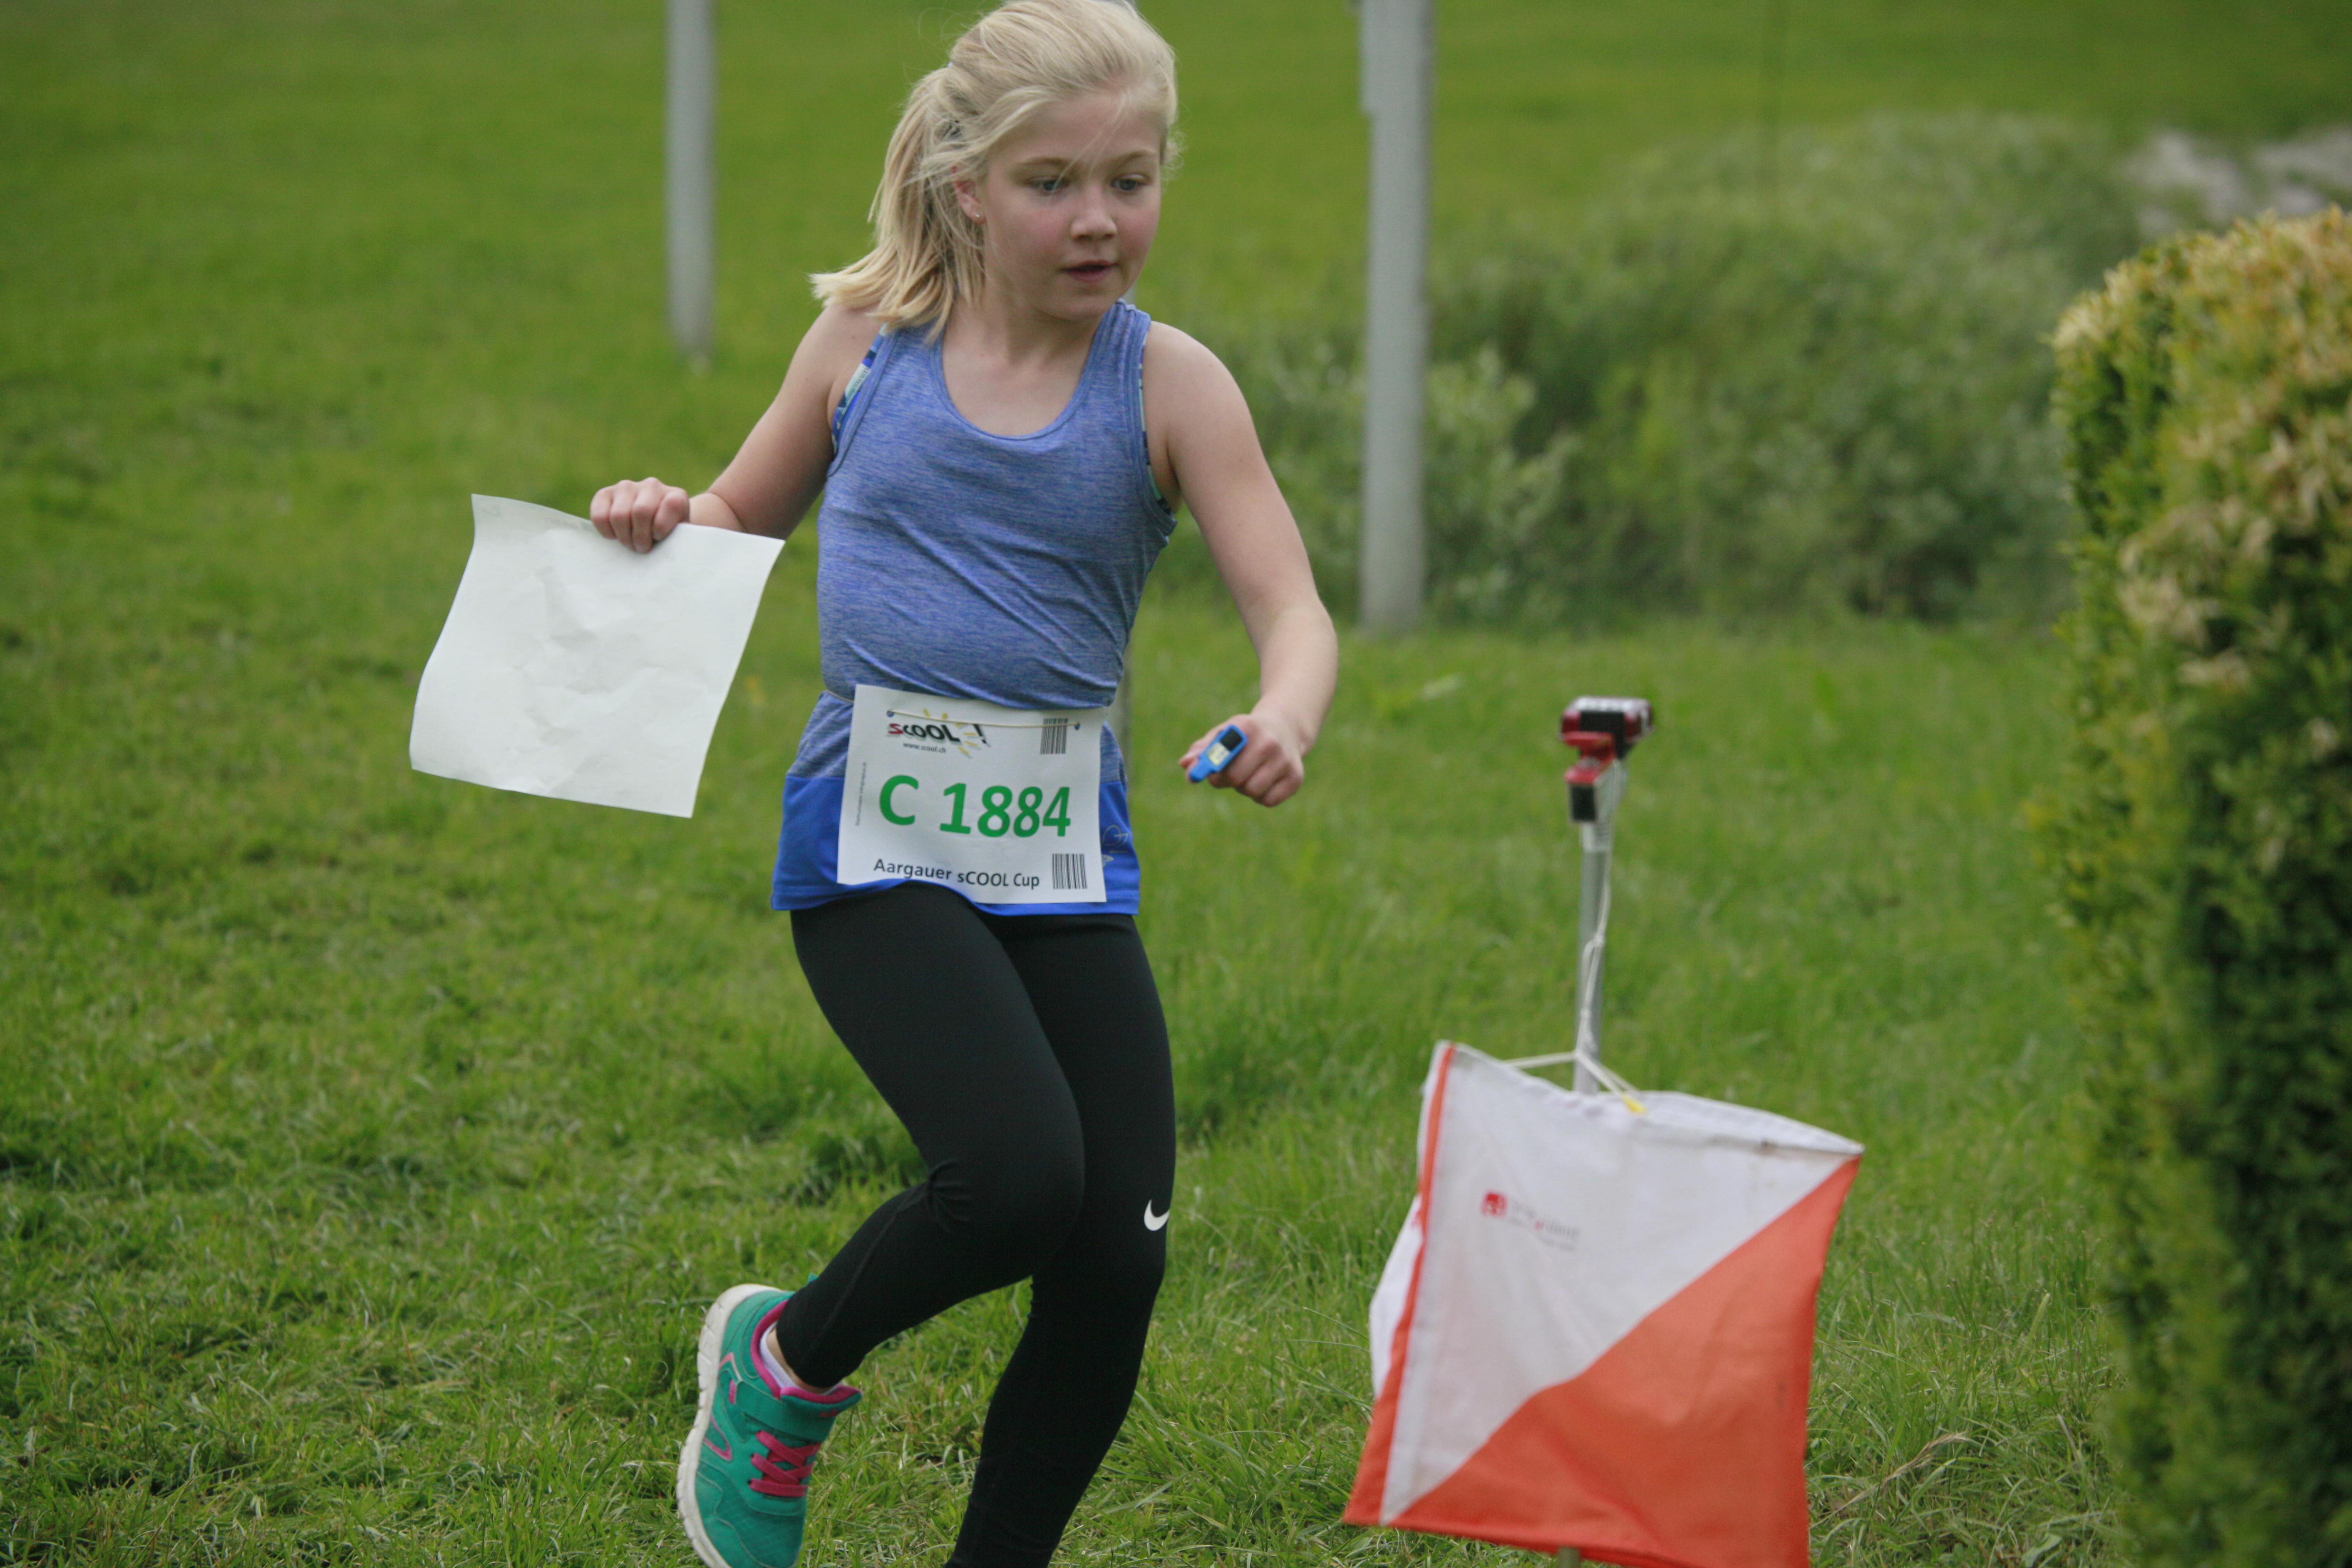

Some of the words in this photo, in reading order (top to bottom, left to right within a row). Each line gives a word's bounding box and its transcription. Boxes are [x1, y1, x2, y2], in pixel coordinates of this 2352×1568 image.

[903, 742, 946, 753] www.scool.ch
[879, 775, 919, 825] C
[940, 783, 1071, 838] 1884
[874, 859, 952, 880] Aargauer
[957, 872, 1009, 887] sCOOL
[1014, 873, 1039, 890] Cup
